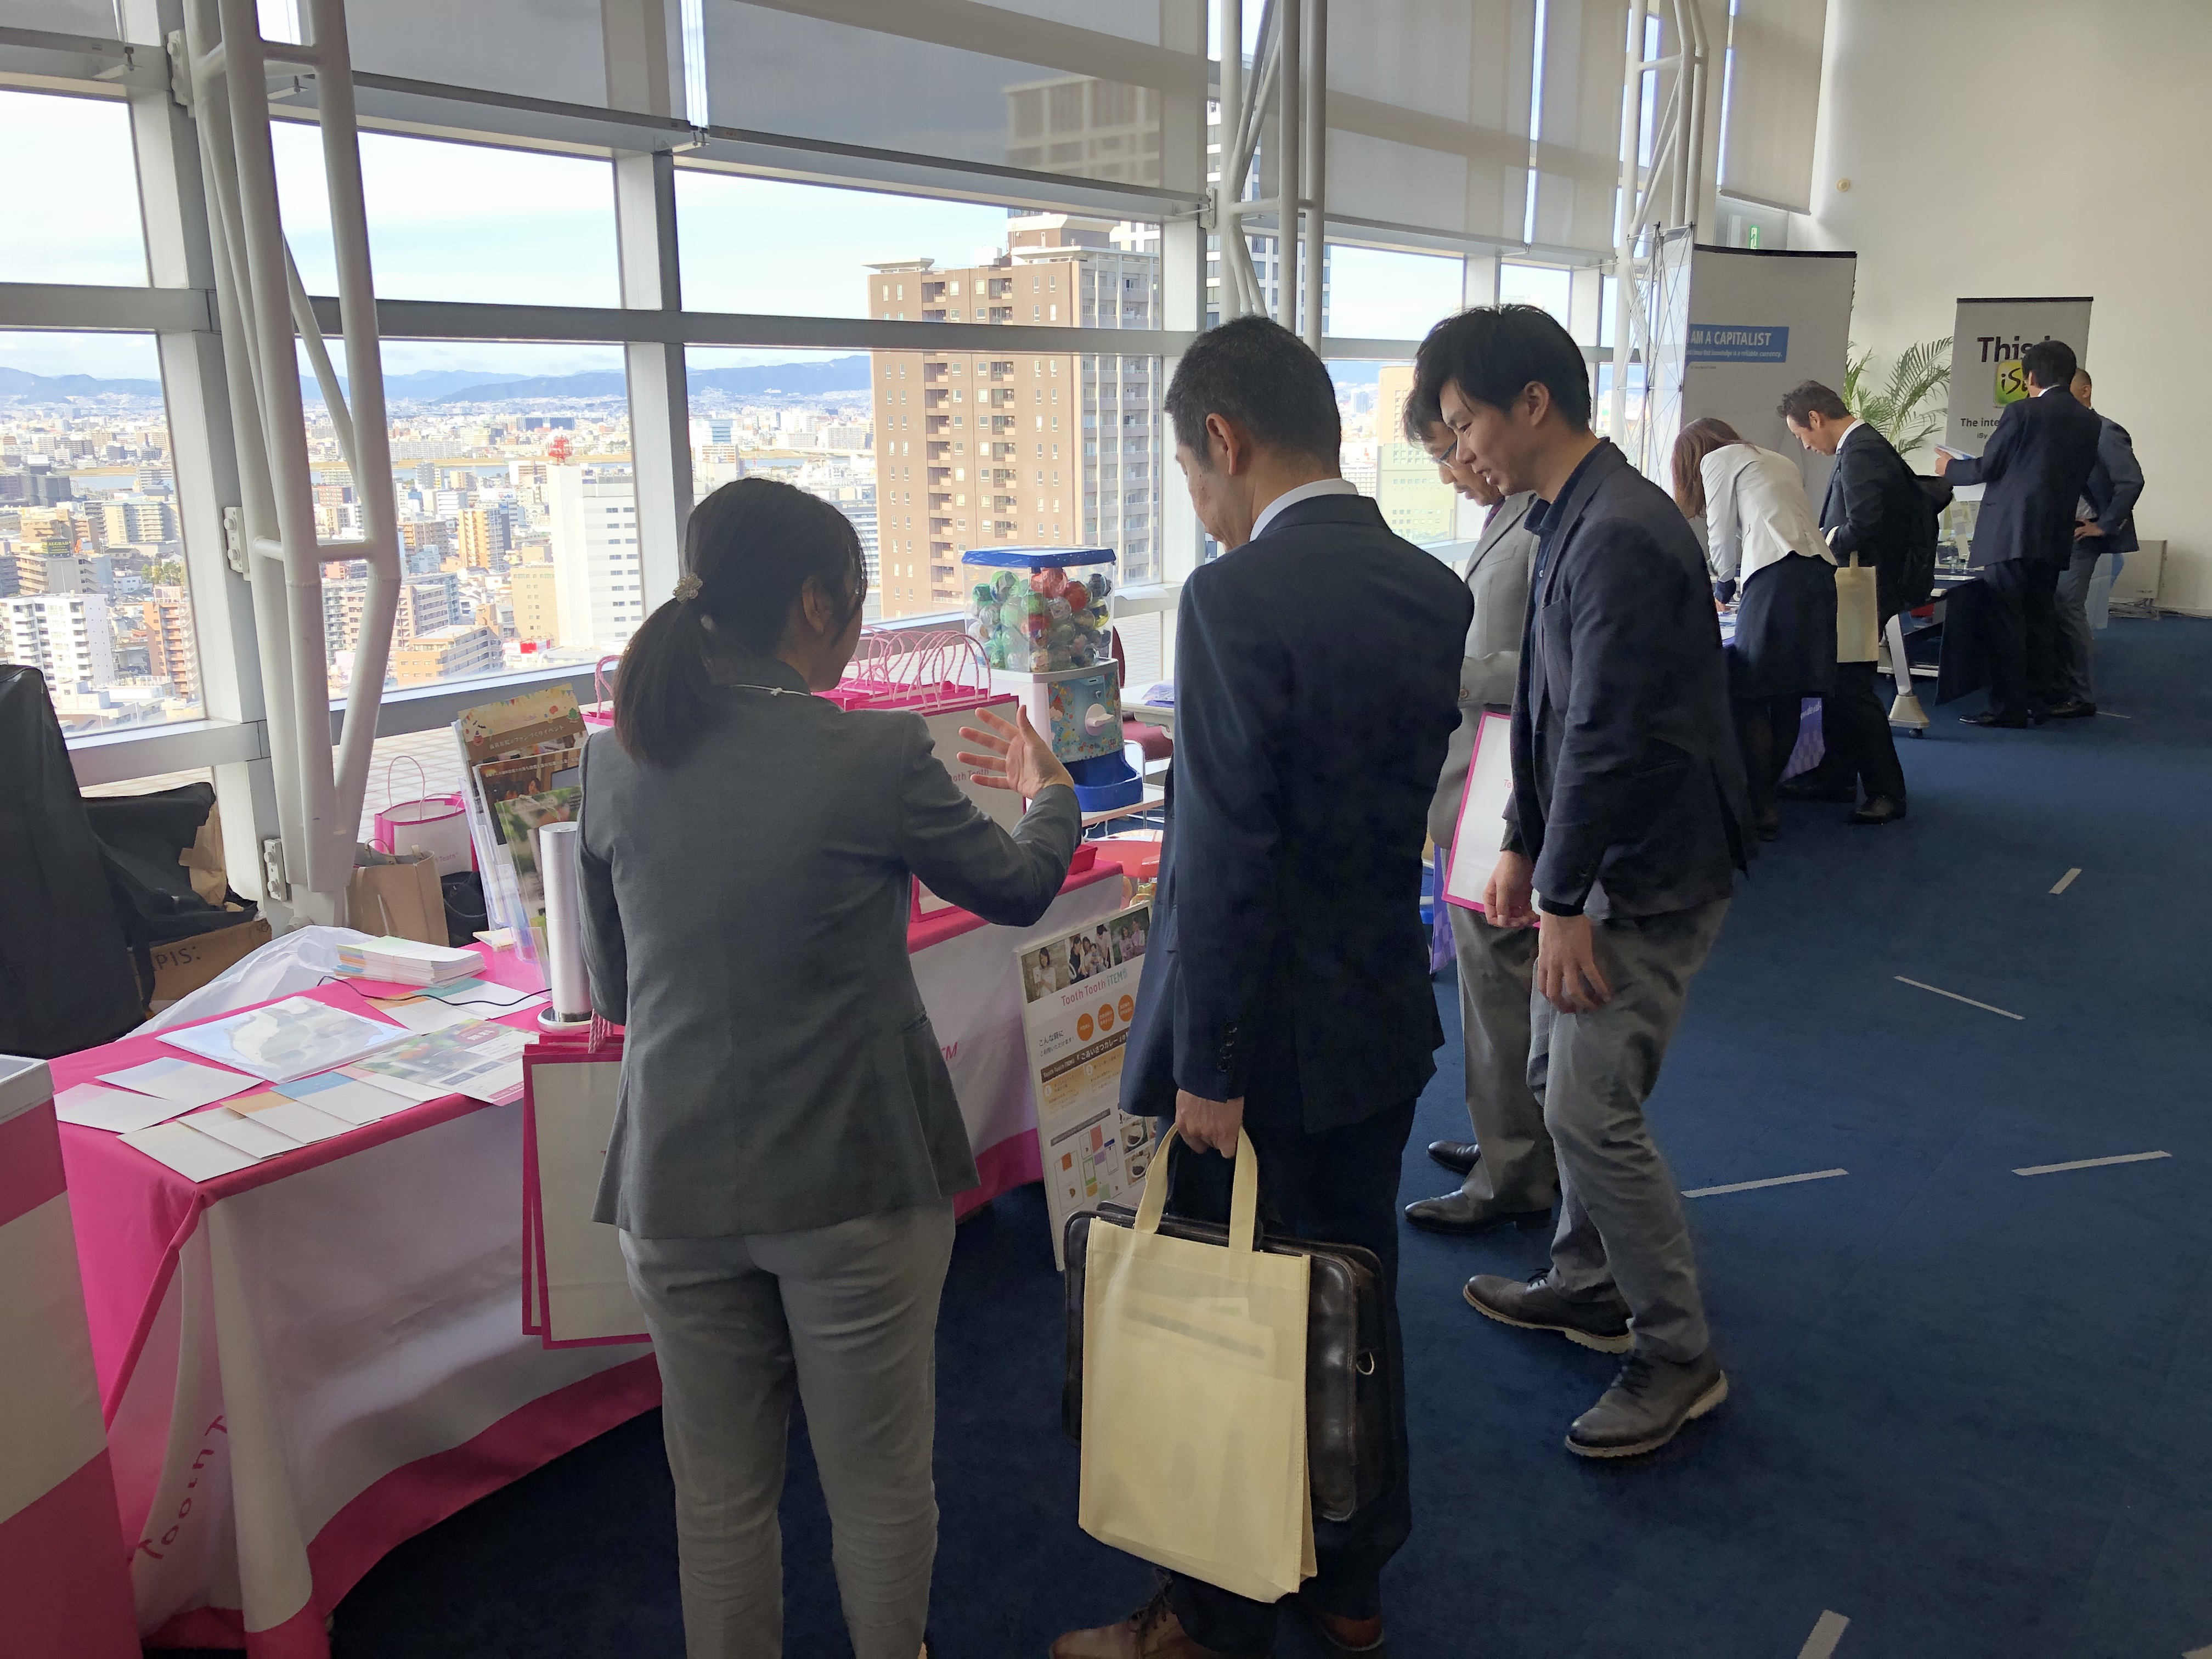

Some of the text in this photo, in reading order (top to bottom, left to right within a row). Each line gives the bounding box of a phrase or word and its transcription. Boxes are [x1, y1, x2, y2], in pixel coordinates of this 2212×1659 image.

[1691, 331, 1771, 346] AM A CAPITALIST
[1960, 418, 2000, 427] The inte
[952, 772, 966, 782] oth
[155, 946, 200, 970] PIS:
[1060, 989, 1084, 1006] Tooth
[1084, 979, 1106, 996] Tooth
[1039, 1030, 1064, 1047] こんな時に
